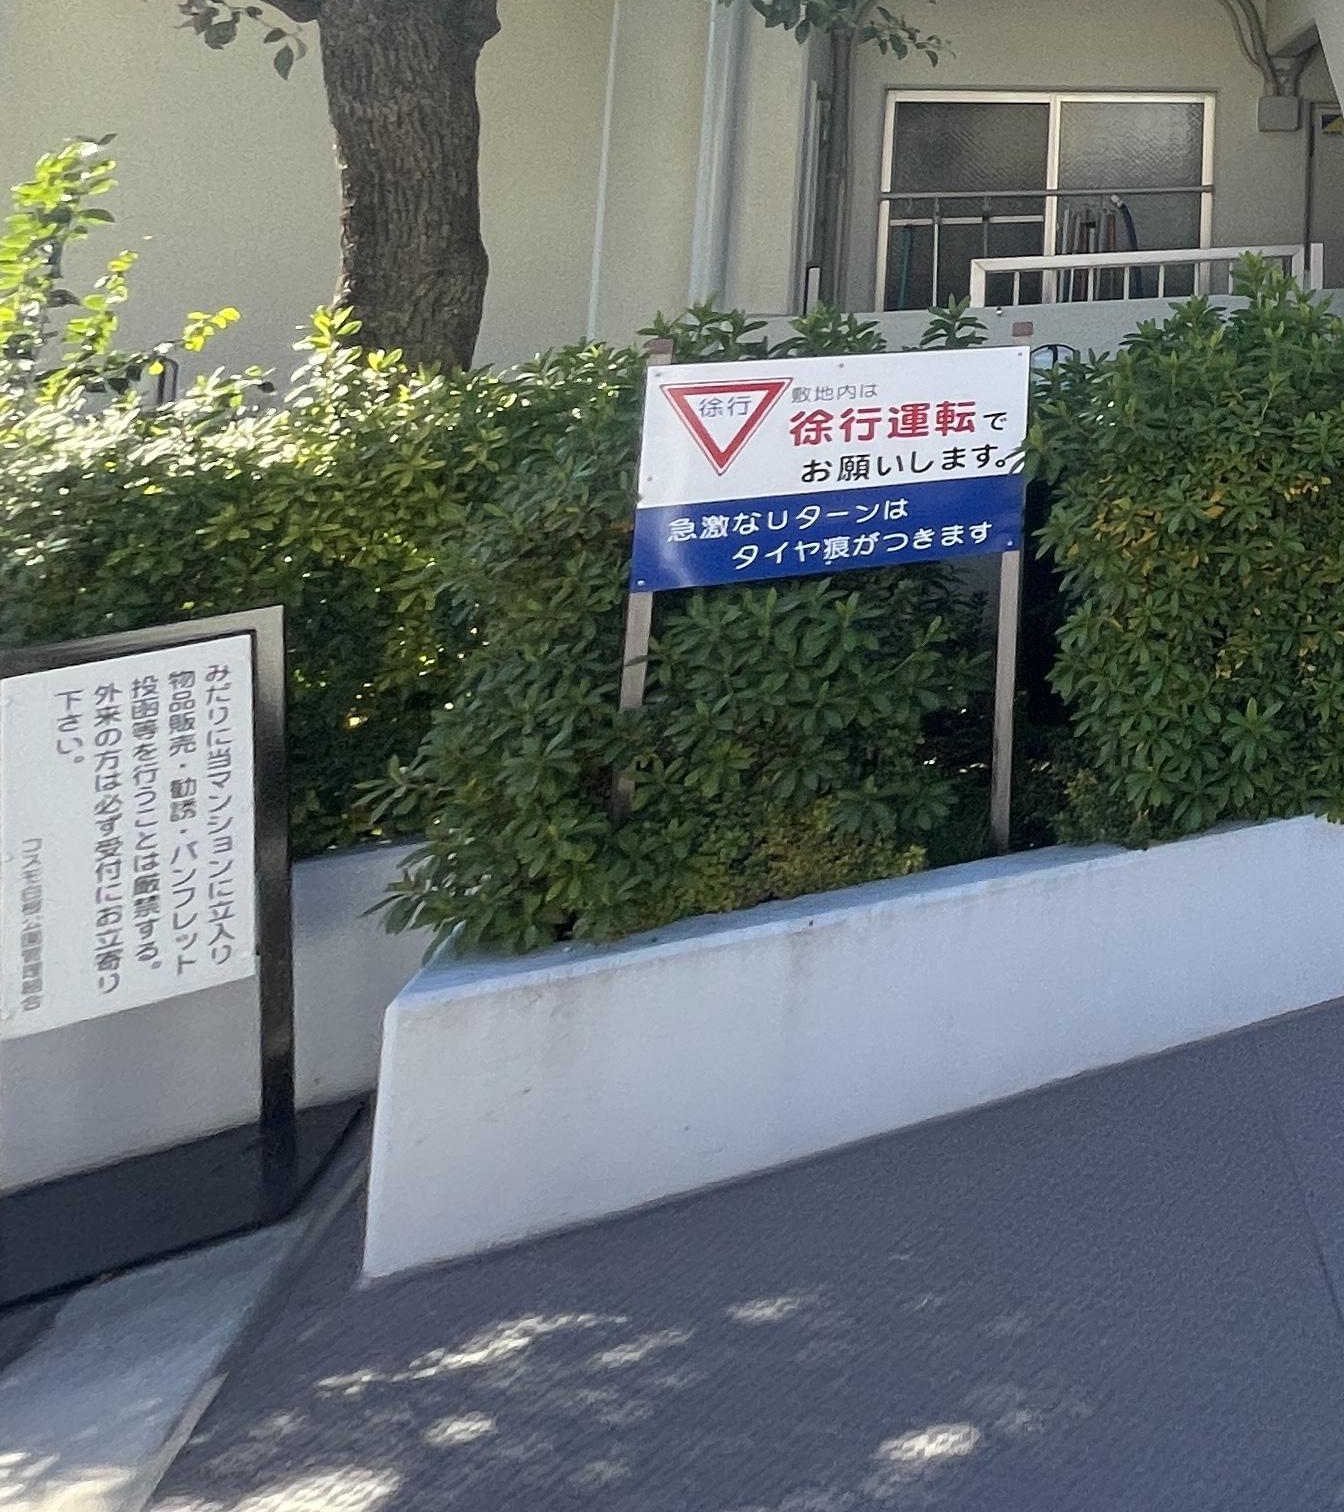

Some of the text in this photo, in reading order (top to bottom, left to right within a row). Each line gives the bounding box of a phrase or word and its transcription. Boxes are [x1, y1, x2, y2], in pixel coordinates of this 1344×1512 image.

[698, 396, 751, 418] 徐行
[791, 383, 878, 404] 敷地内は
[788, 400, 1008, 447] 徐行運転で
[800, 443, 1008, 483] お願いします。
[667, 498, 909, 543] 急激なUターンは
[731, 522, 993, 570] タイヤ痕がつきます
[54, 690, 86, 765] 下さい。
[93, 683, 124, 993] 外来の方は必ず受付にお立寄り
[131, 677, 161, 971] 投函等を行うことは厳禁する。
[203, 663, 236, 966] みだりに当マンションに立入り
